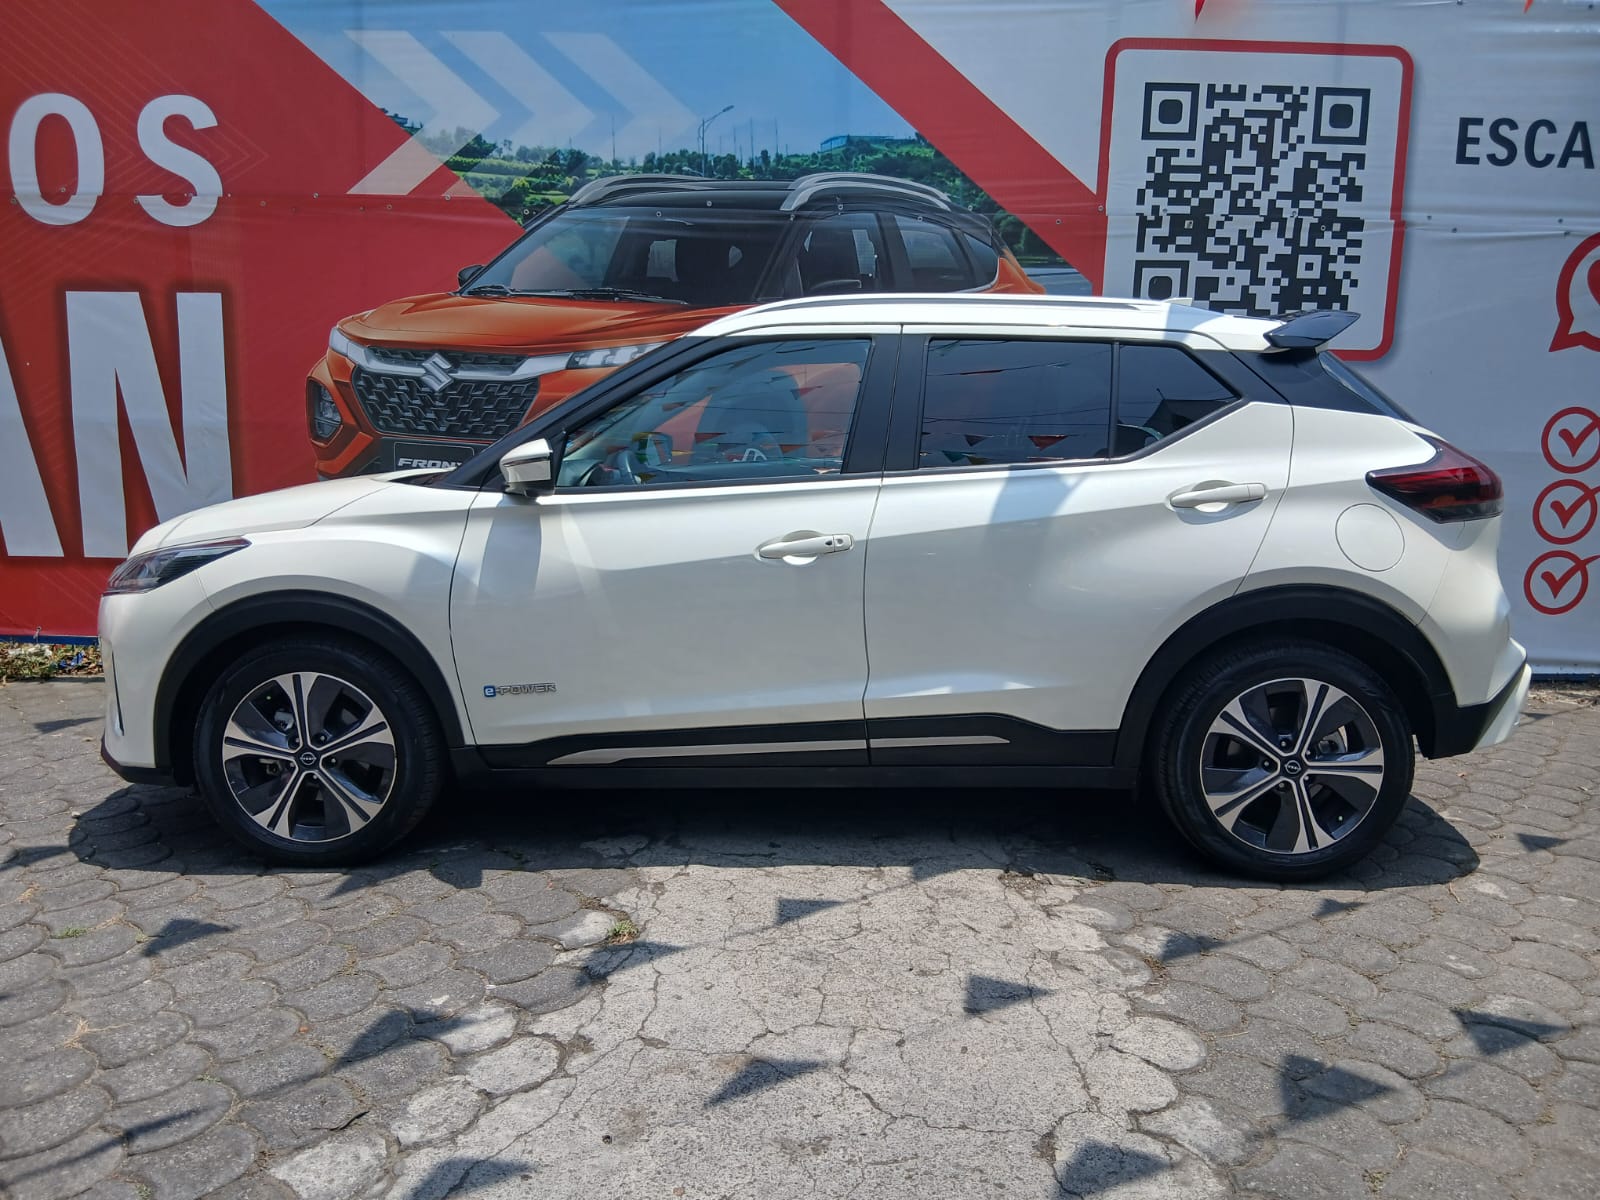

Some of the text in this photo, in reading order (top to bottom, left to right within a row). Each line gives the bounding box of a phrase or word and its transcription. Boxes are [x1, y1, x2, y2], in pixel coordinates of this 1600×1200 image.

[9, 92, 223, 226] OS
[1456, 117, 1595, 169] ESCA
[397, 457, 463, 469] FRON
[483, 682, 557, 698] e-POWER
